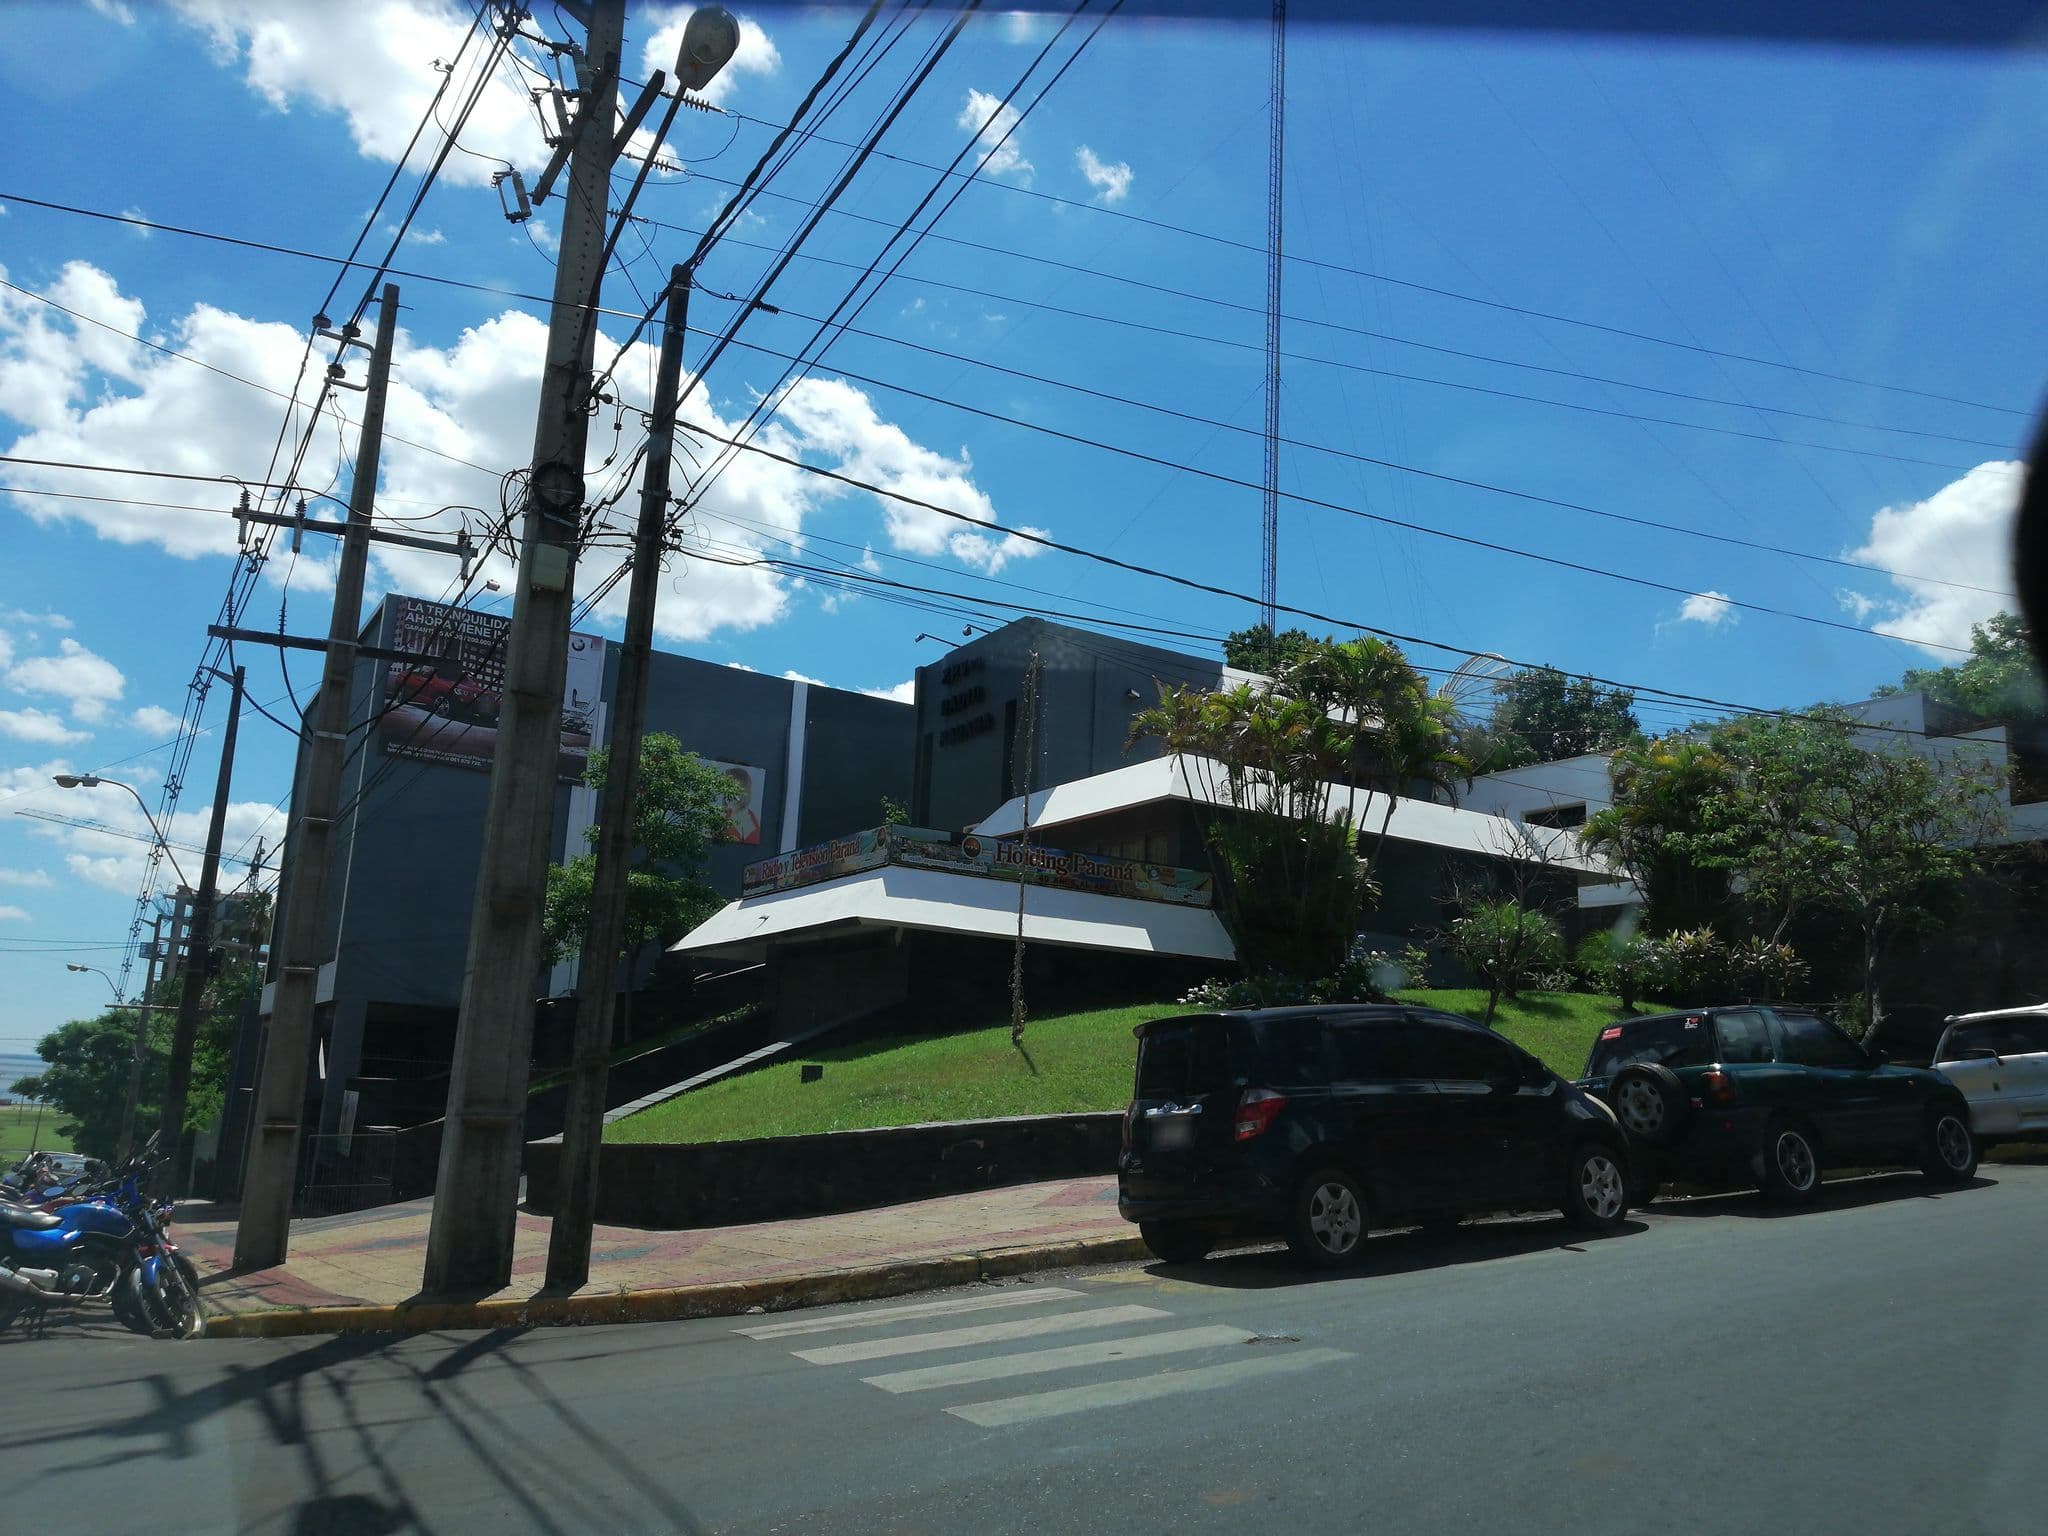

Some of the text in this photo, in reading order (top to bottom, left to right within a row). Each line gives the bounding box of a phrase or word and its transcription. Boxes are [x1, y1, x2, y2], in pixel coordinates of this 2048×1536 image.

[407, 600, 424, 613] LA
[405, 612, 451, 631] AHORA
[455, 621, 491, 638] VIENE
[761, 859, 784, 880] Radio
[994, 841, 1069, 876] Holding
[1071, 853, 1135, 881] Paraná
